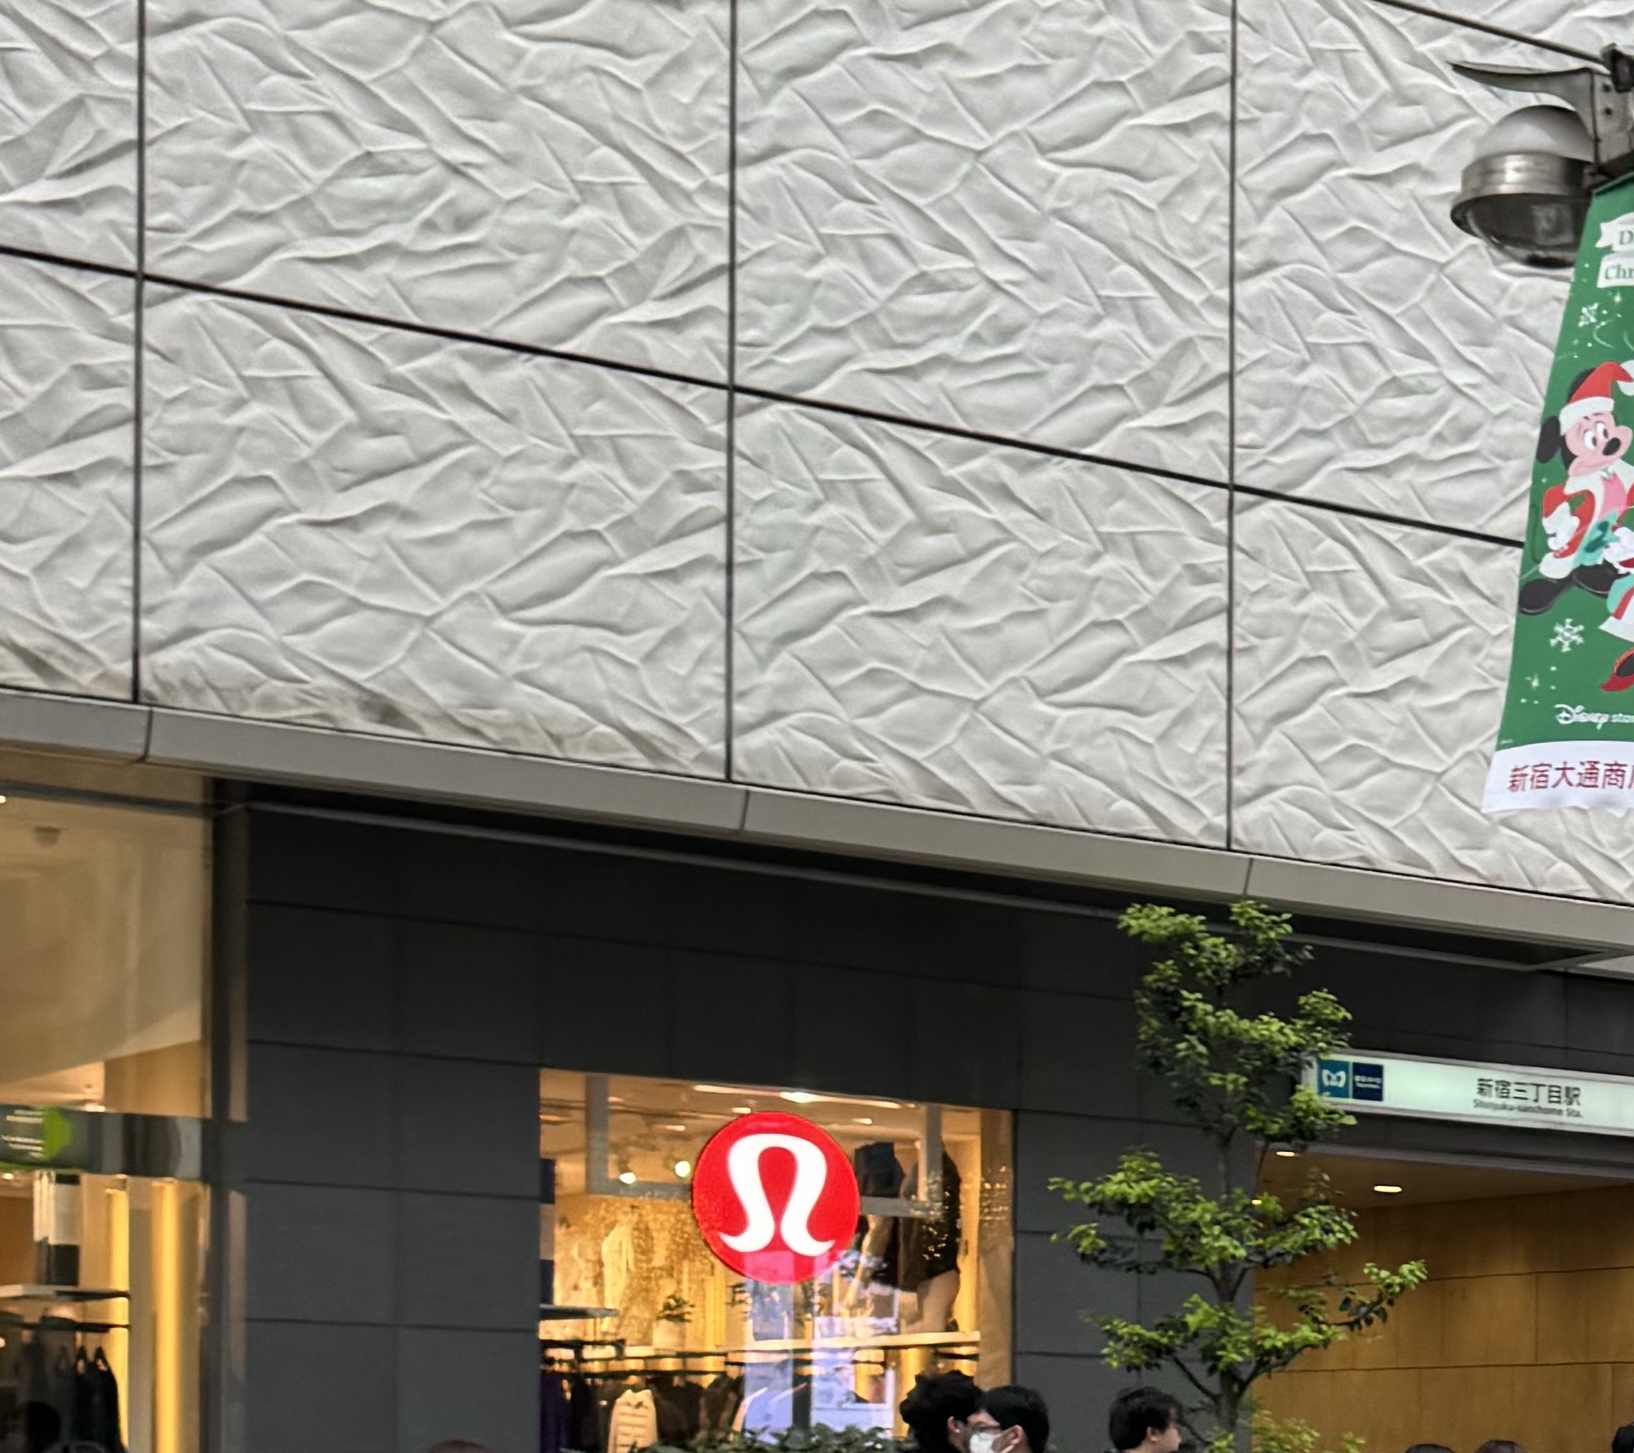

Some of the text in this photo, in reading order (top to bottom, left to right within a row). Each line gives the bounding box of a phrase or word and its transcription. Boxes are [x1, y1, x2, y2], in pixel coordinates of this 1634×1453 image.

[1554, 704, 1609, 730] Disney
[1477, 1078, 1581, 1106] 新宿三丁目駅
